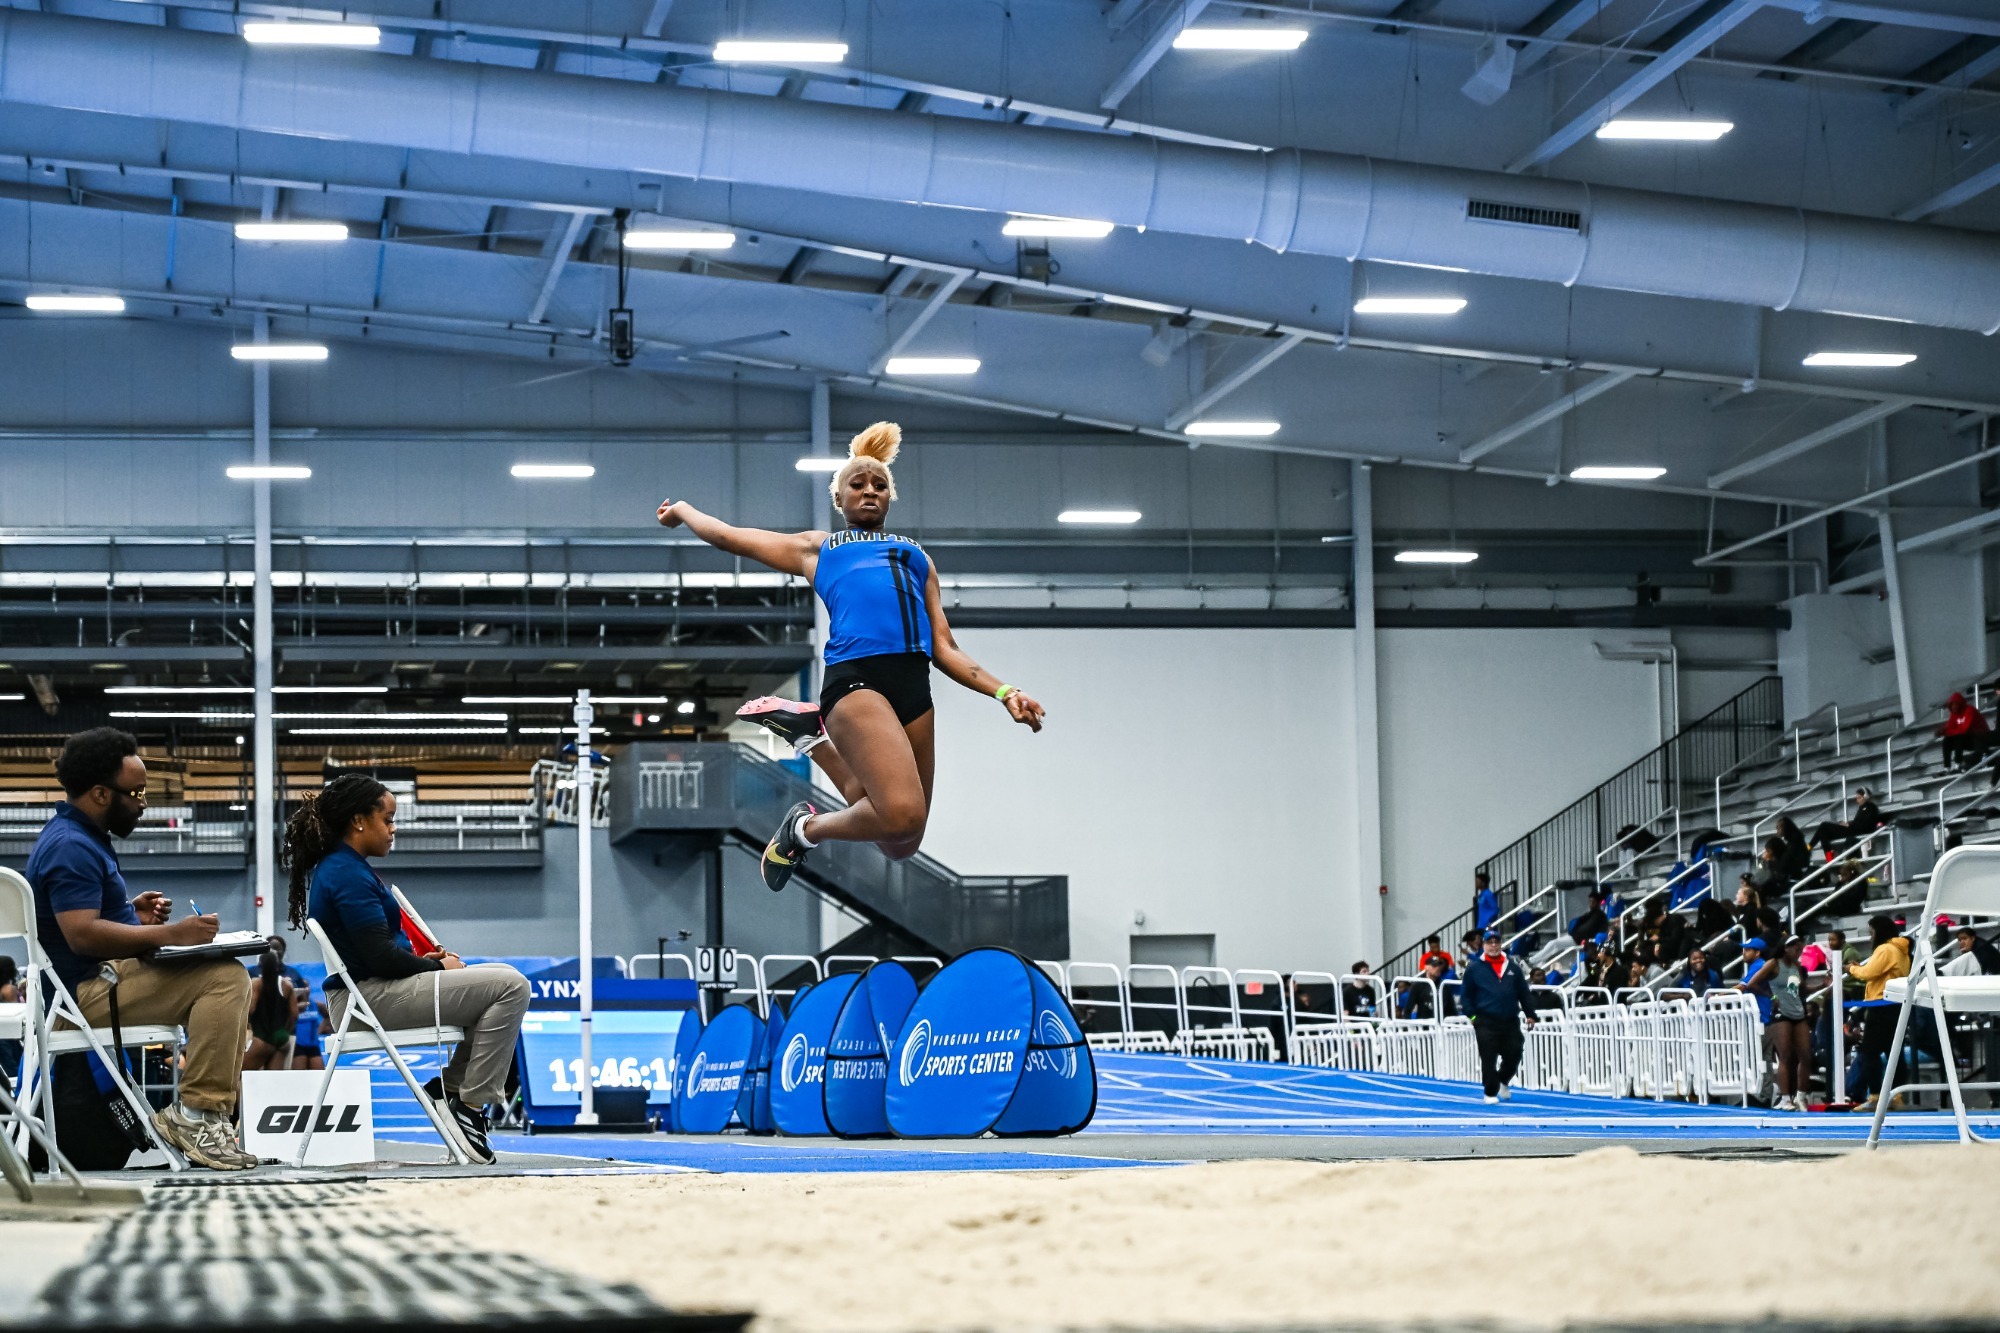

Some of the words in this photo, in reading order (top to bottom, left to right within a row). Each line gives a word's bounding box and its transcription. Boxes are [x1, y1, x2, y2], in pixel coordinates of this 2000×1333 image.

[932, 1033, 980, 1047] VIRGINIA
[986, 1029, 1021, 1043] BEACH
[549, 1057, 675, 1092] 11:46:1
[924, 1054, 966, 1077] SPORTS
[969, 1052, 1014, 1075] CENTER
[256, 1104, 362, 1134] GILL
